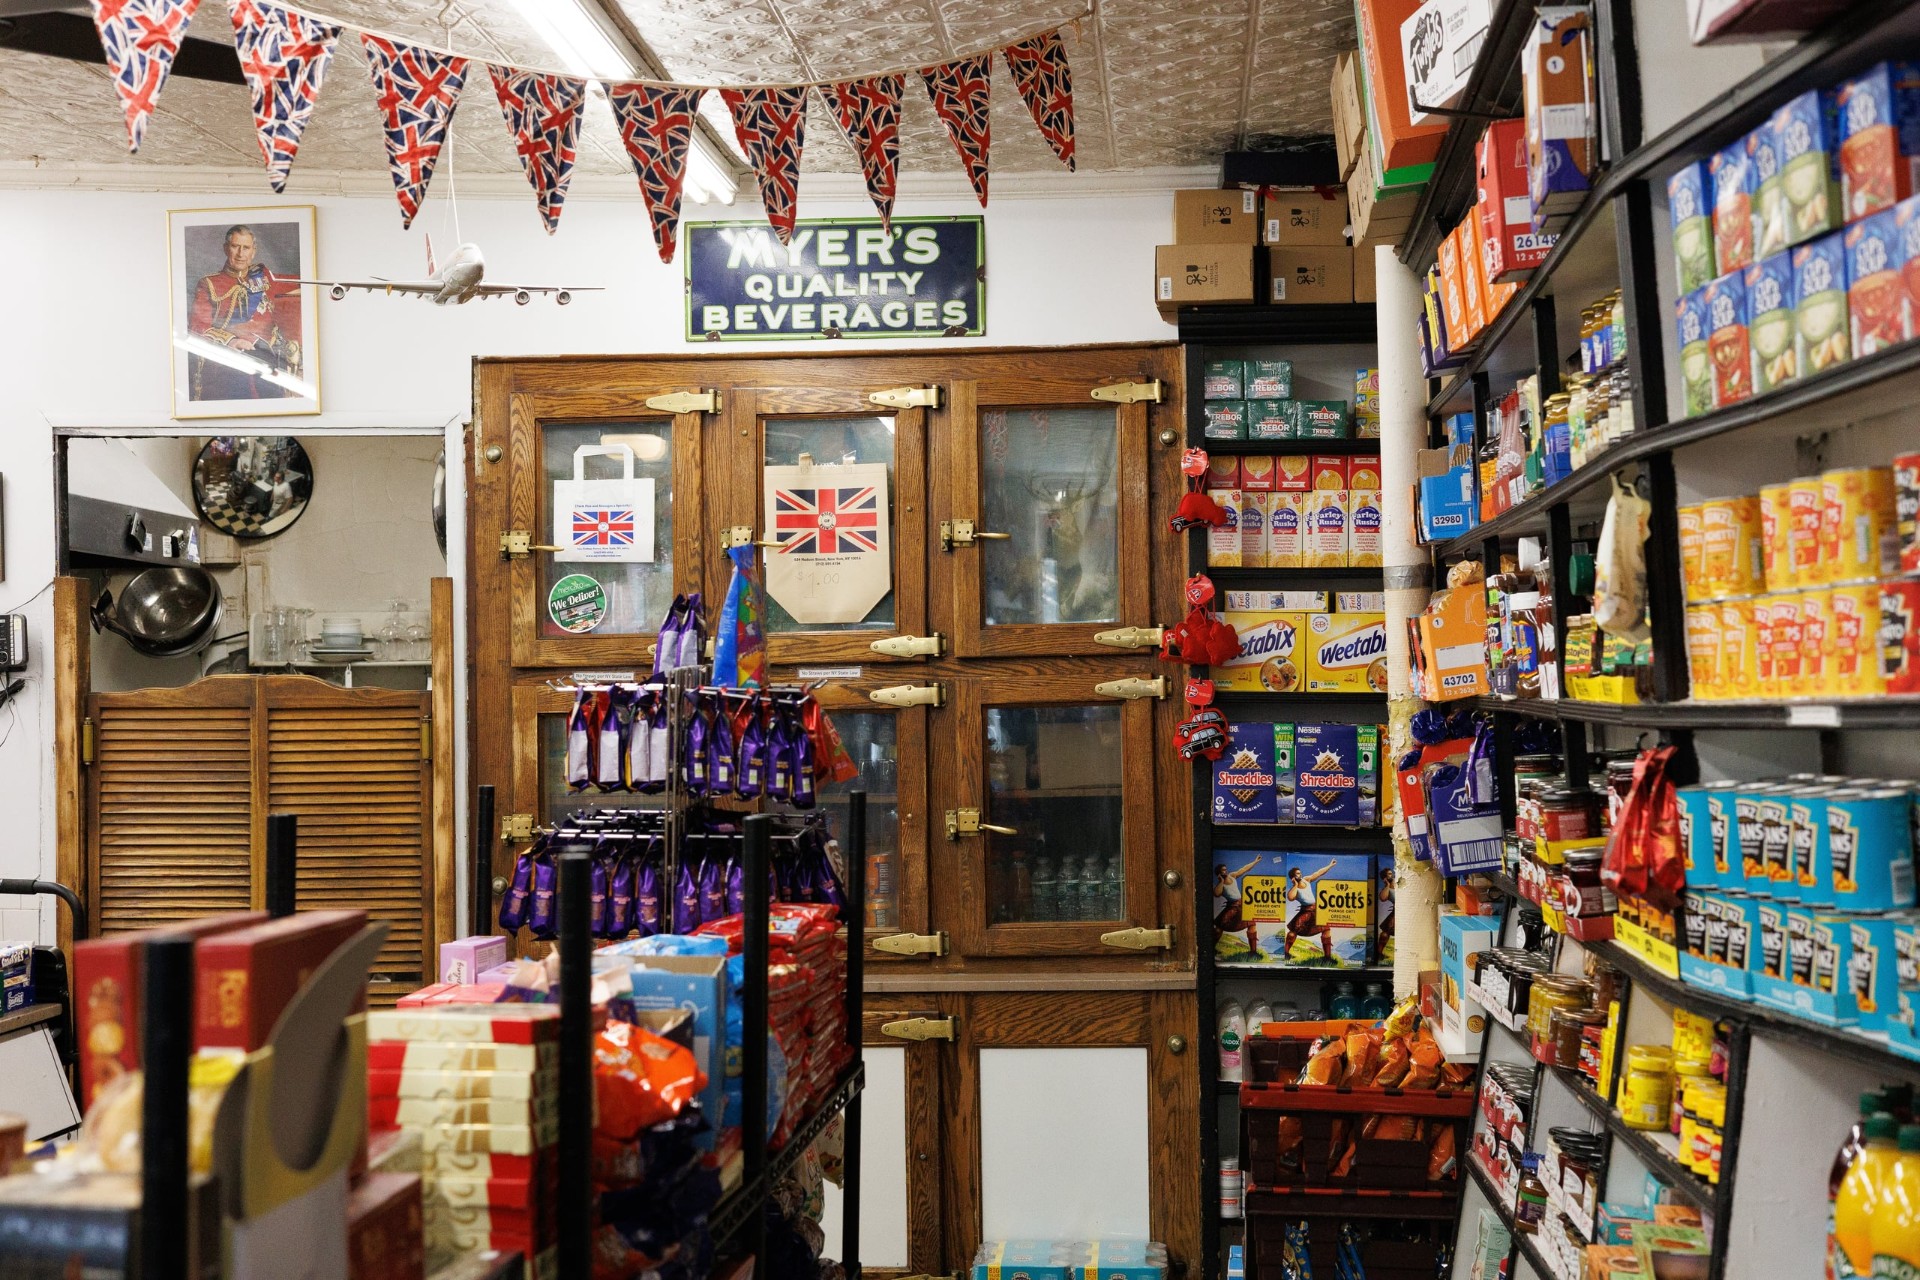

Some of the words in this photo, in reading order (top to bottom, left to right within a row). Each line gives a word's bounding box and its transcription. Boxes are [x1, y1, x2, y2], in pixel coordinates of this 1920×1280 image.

[727, 225, 940, 268] MYER'S
[1516, 234, 1556, 249] 26148
[1516, 253, 1526, 261] 12
[745, 271, 923, 302] QUALITY
[703, 300, 968, 331] BEVERAGES
[1207, 384, 1235, 392] REBOR
[1250, 384, 1284, 392] TREBOR
[1211, 413, 1242, 421] TREBOR
[1308, 412, 1340, 420] TREBOR
[1270, 512, 1299, 523] Farley's
[1314, 511, 1347, 520] Farley's
[1434, 515, 1461, 525] 32980
[552, 599, 567, 611] We
[566, 585, 600, 606] Deliver!
[1321, 629, 1387, 665] Weetabi
[1443, 673, 1475, 687] 43702
[1275, 733, 1293, 741] WIN
[1358, 735, 1376, 743] WIN
[1218, 770, 1273, 785] Shreddies
[1300, 772, 1355, 788] Shreddies
[1228, 800, 1237, 810] THE
[1238, 801, 1263, 812] ORIGINAL
[1309, 802, 1319, 812] THE
[1320, 803, 1345, 814] ORIGINAL
[879, 863, 889, 876] BRU
[879, 876, 889, 894] IRN
[1318, 889, 1365, 910] Scott's
[453, 962, 464, 985] pling
